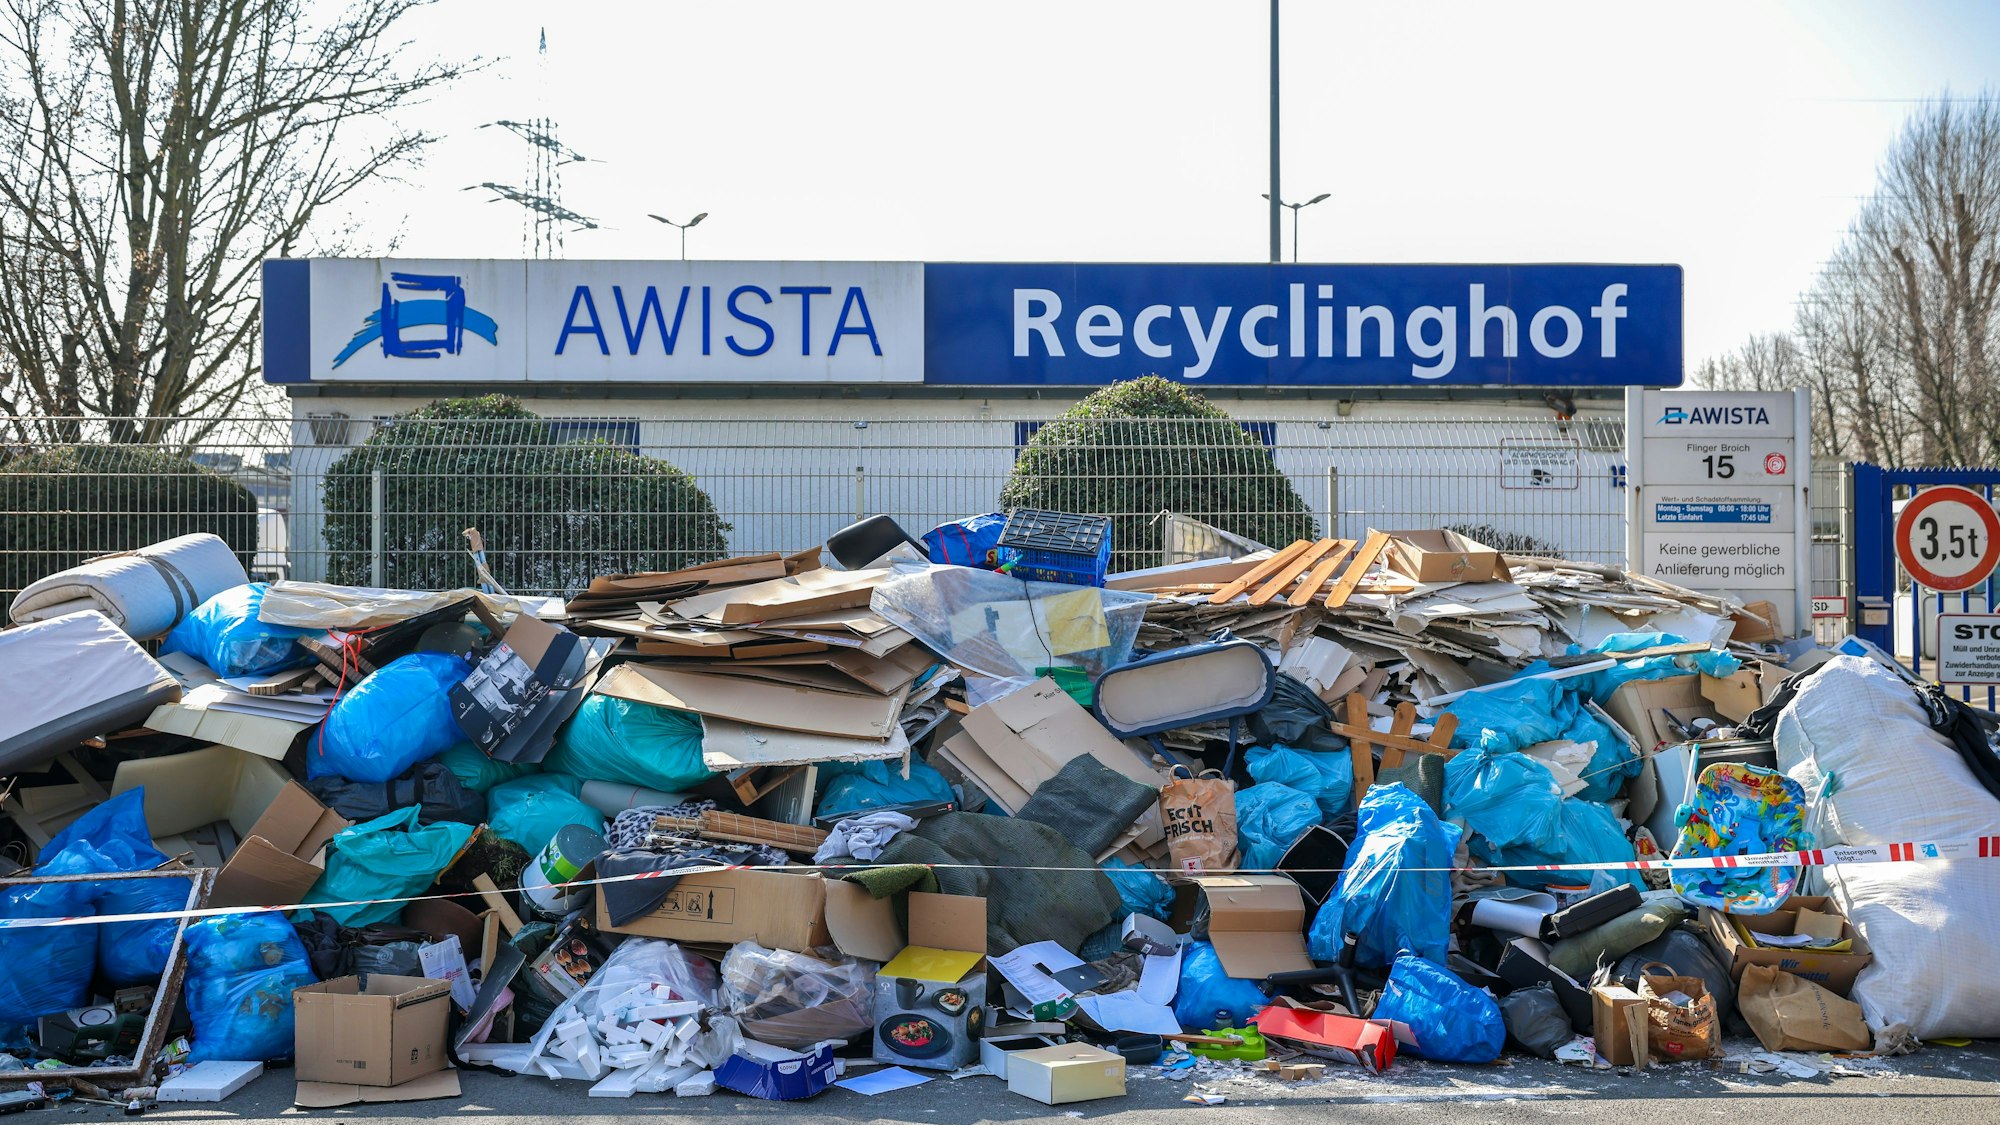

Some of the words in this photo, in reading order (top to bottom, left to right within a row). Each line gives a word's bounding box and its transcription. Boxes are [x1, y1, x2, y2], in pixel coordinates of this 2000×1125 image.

[554, 284, 883, 357] AWISTA
[1012, 283, 1628, 379] Recyclinghof
[1689, 407, 1769, 425] AWISTA
[1687, 443, 1717, 453] Flinger
[1721, 443, 1750, 452] Broich
[1702, 455, 1735, 479] 15
[1657, 504, 1681, 513] Montag
[1686, 504, 1713, 513] Samstag
[1657, 513, 1677, 521] Letzte
[1678, 513, 1703, 521] Einfahrt
[1659, 543, 1697, 555] Keine
[1701, 543, 1780, 558] gewerbliche
[1655, 563, 1730, 578] Anlieferung
[1734, 563, 1785, 578] möglich
[1968, 670, 1994, 678] Anzeige
[1164, 820, 1213, 839] FRISCH
